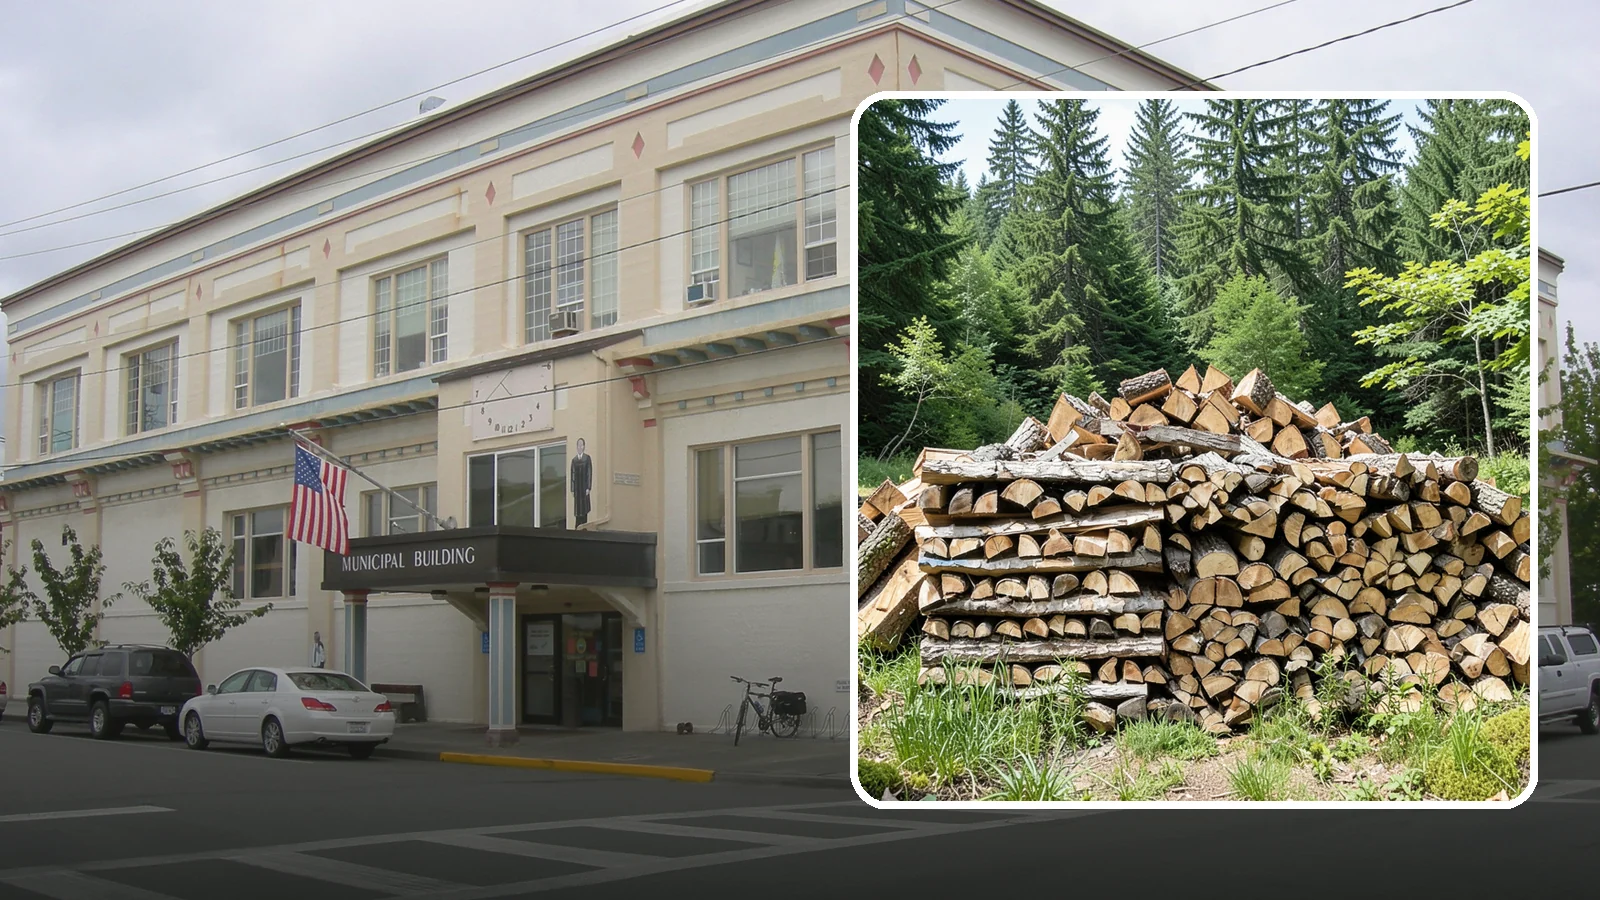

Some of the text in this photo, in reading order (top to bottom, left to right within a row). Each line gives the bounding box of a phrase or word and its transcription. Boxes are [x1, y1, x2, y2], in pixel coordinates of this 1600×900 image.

[480, 406, 485, 415] 8
[536, 402, 540, 410] 4
[487, 417, 492, 426] 9
[529, 414, 533, 422] 3
[494, 423, 500, 432] 10
[521, 420, 526, 428] 2
[507, 425, 514, 434] 12
[342, 546, 475, 572] MUNICIPAL BUILDING
